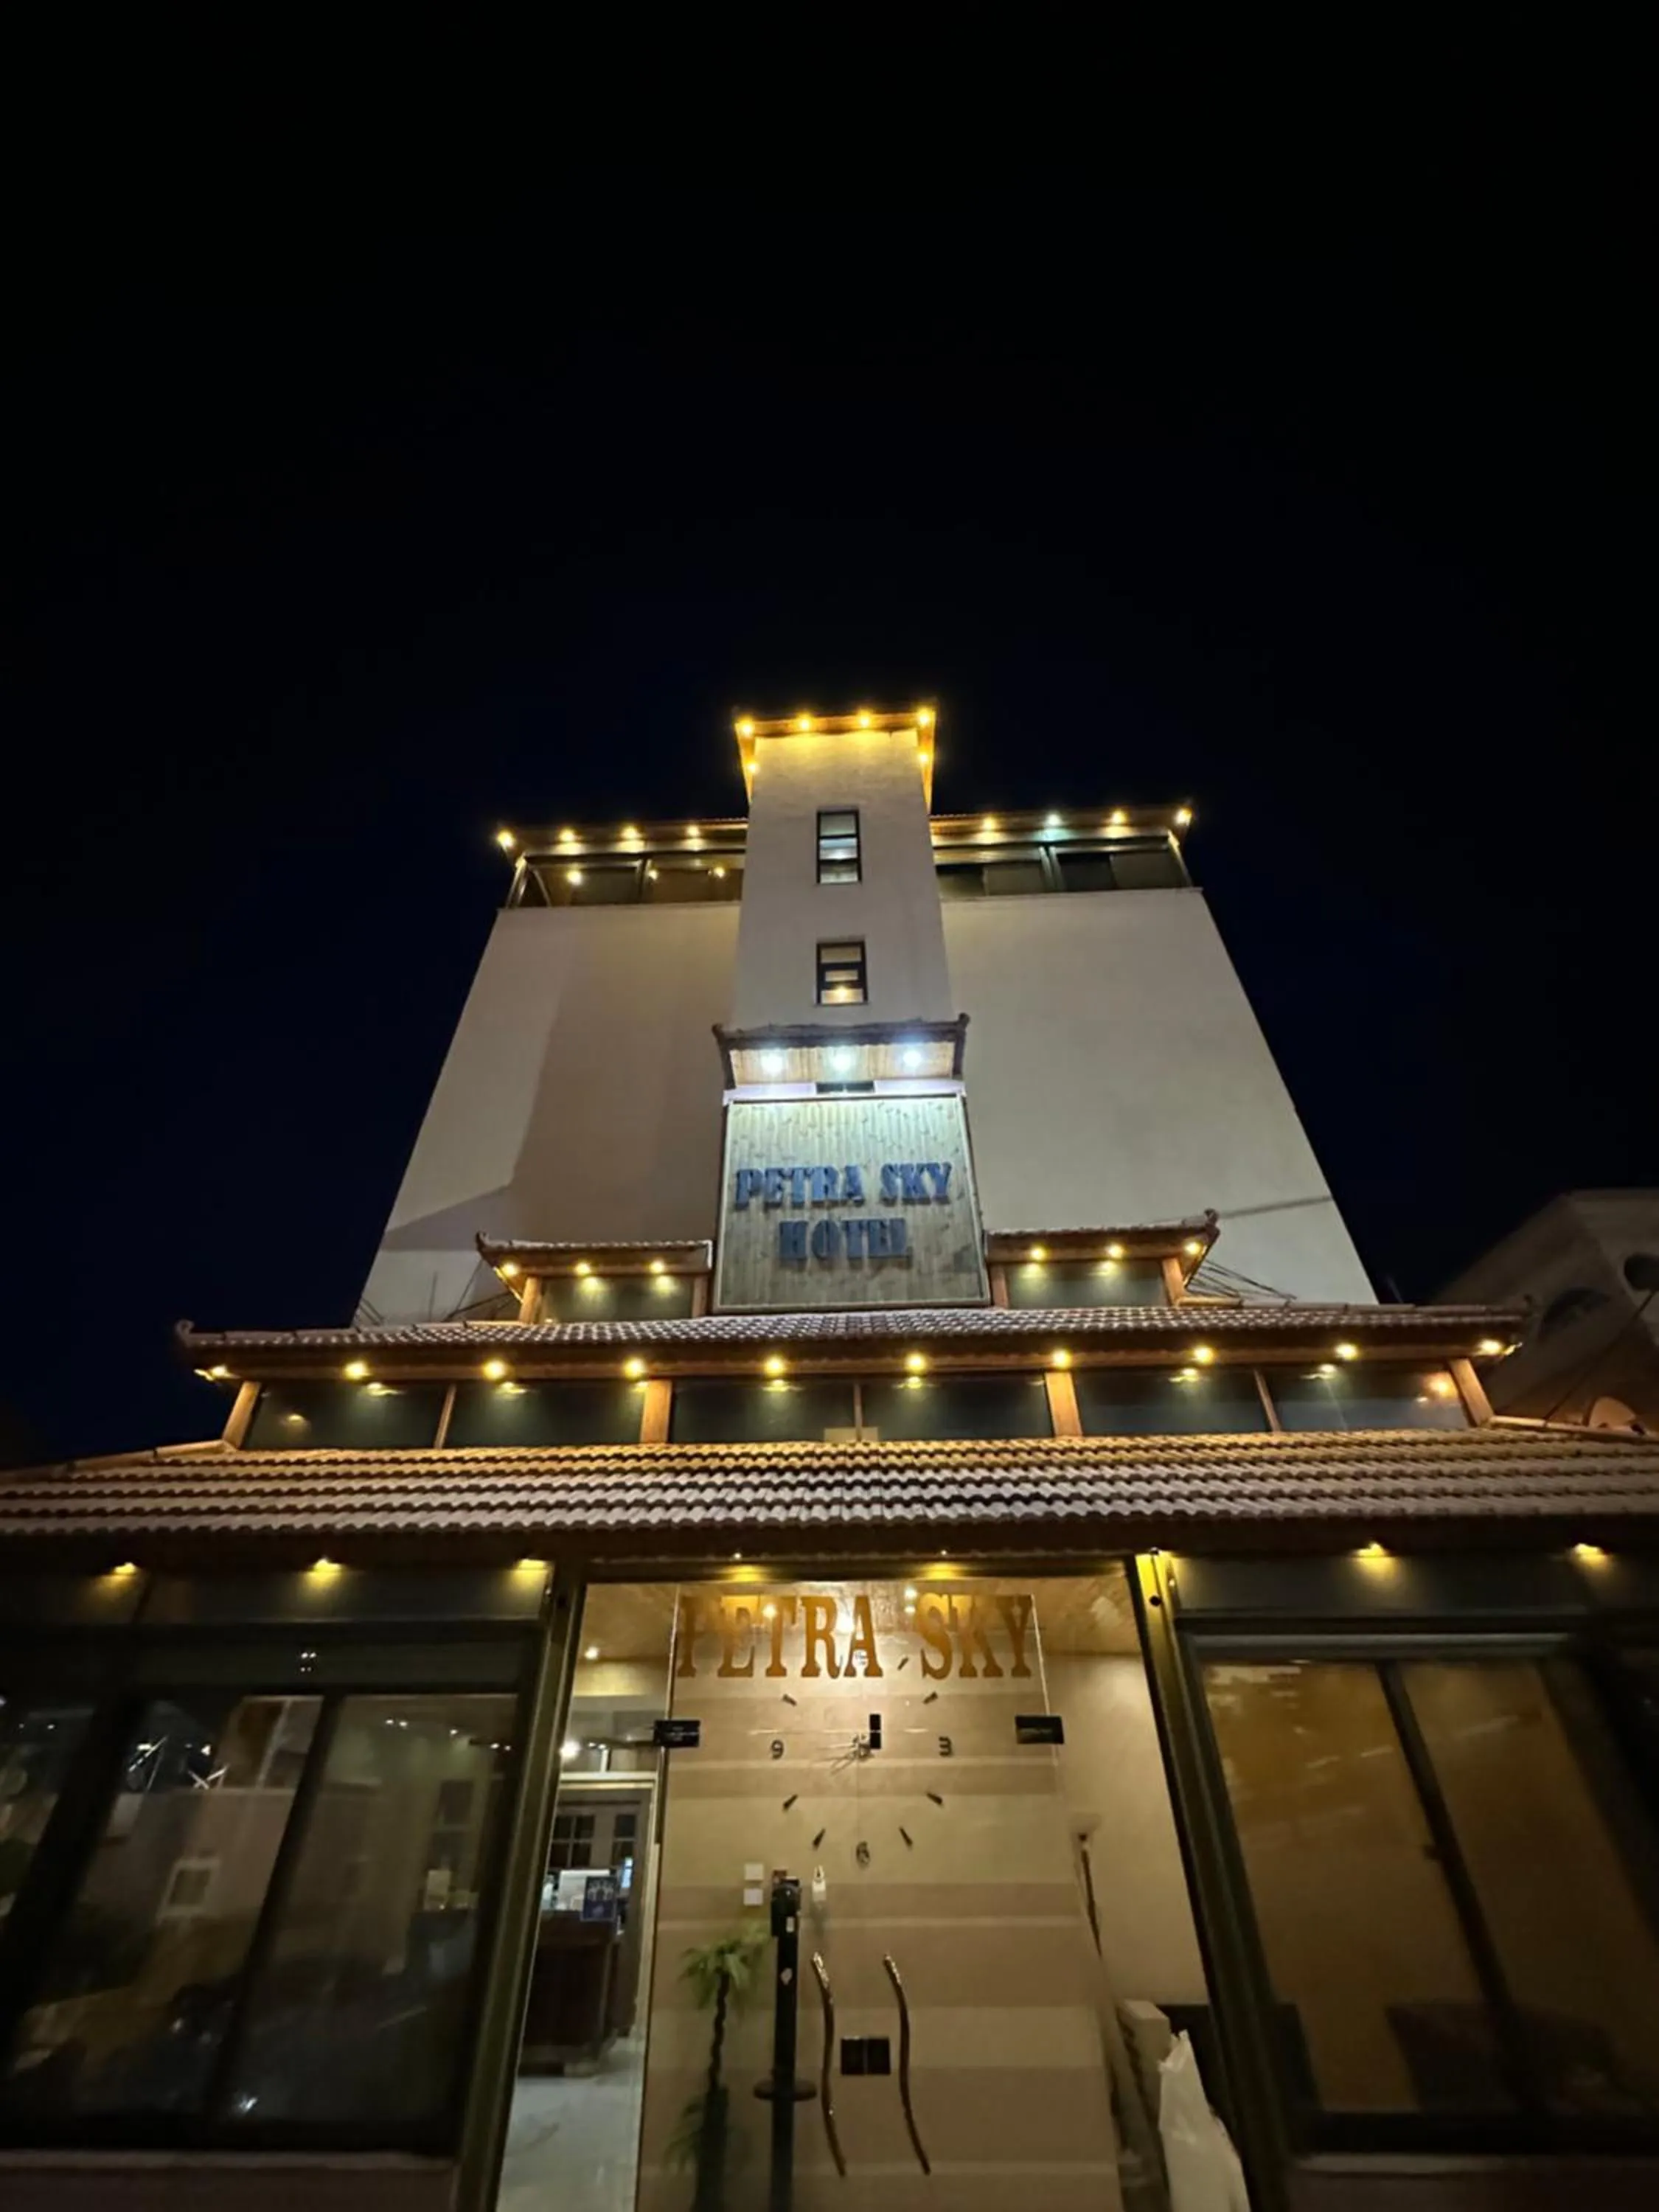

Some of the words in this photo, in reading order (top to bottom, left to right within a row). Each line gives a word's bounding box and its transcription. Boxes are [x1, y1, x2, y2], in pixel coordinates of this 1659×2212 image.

[734, 1165, 865, 1210] PETRA
[880, 1162, 952, 1205] SKY
[779, 1217, 913, 1262] HOTEL
[676, 1594, 883, 1679] PETRA
[917, 1592, 1032, 1680] SKY
[771, 1739, 785, 1760] 9
[938, 1736, 953, 1757] 3
